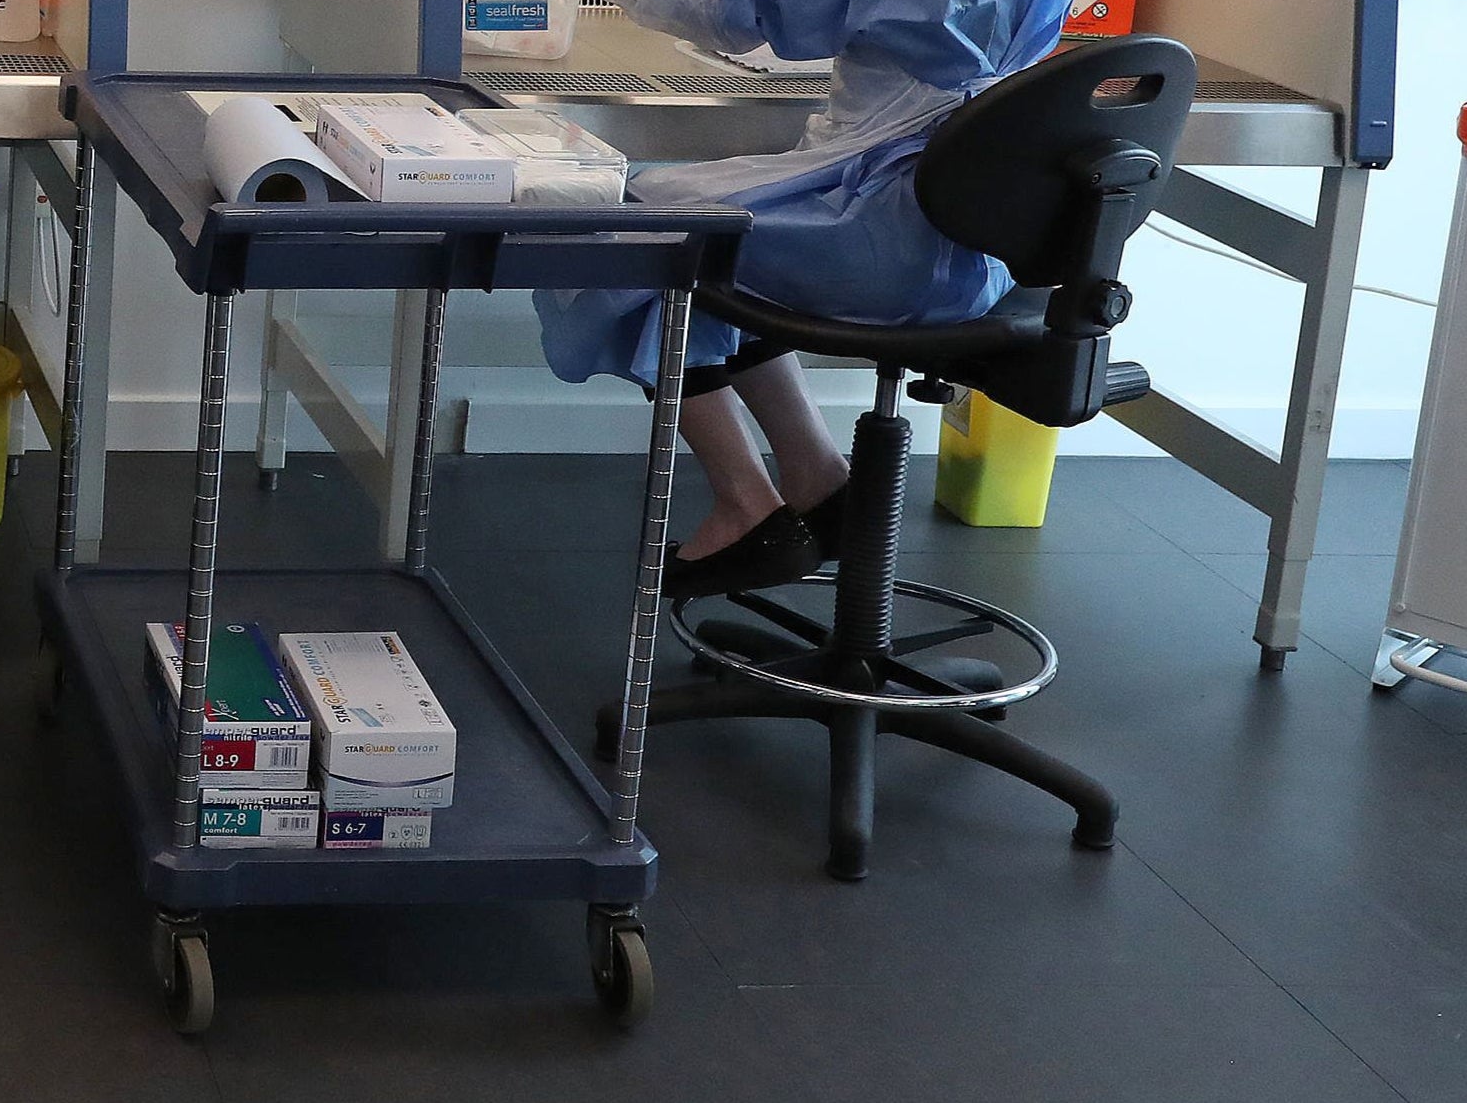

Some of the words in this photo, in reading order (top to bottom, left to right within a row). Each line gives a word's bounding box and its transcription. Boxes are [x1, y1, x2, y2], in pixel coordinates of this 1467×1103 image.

[486, 4, 545, 16] sealfresh
[1072, 6, 1079, 16] 6
[453, 173, 496, 181] COMFORT
[205, 724, 297, 736] emperguard
[223, 734, 253, 742] nitrile
[397, 745, 439, 753] COMFORT
[203, 754, 212, 767] L
[215, 754, 240, 767] 8-9
[238, 802, 265, 811] latex
[203, 812, 217, 825] M
[223, 812, 247, 825] 7-8
[332, 823, 341, 835] S
[345, 823, 367, 835] 6-7
